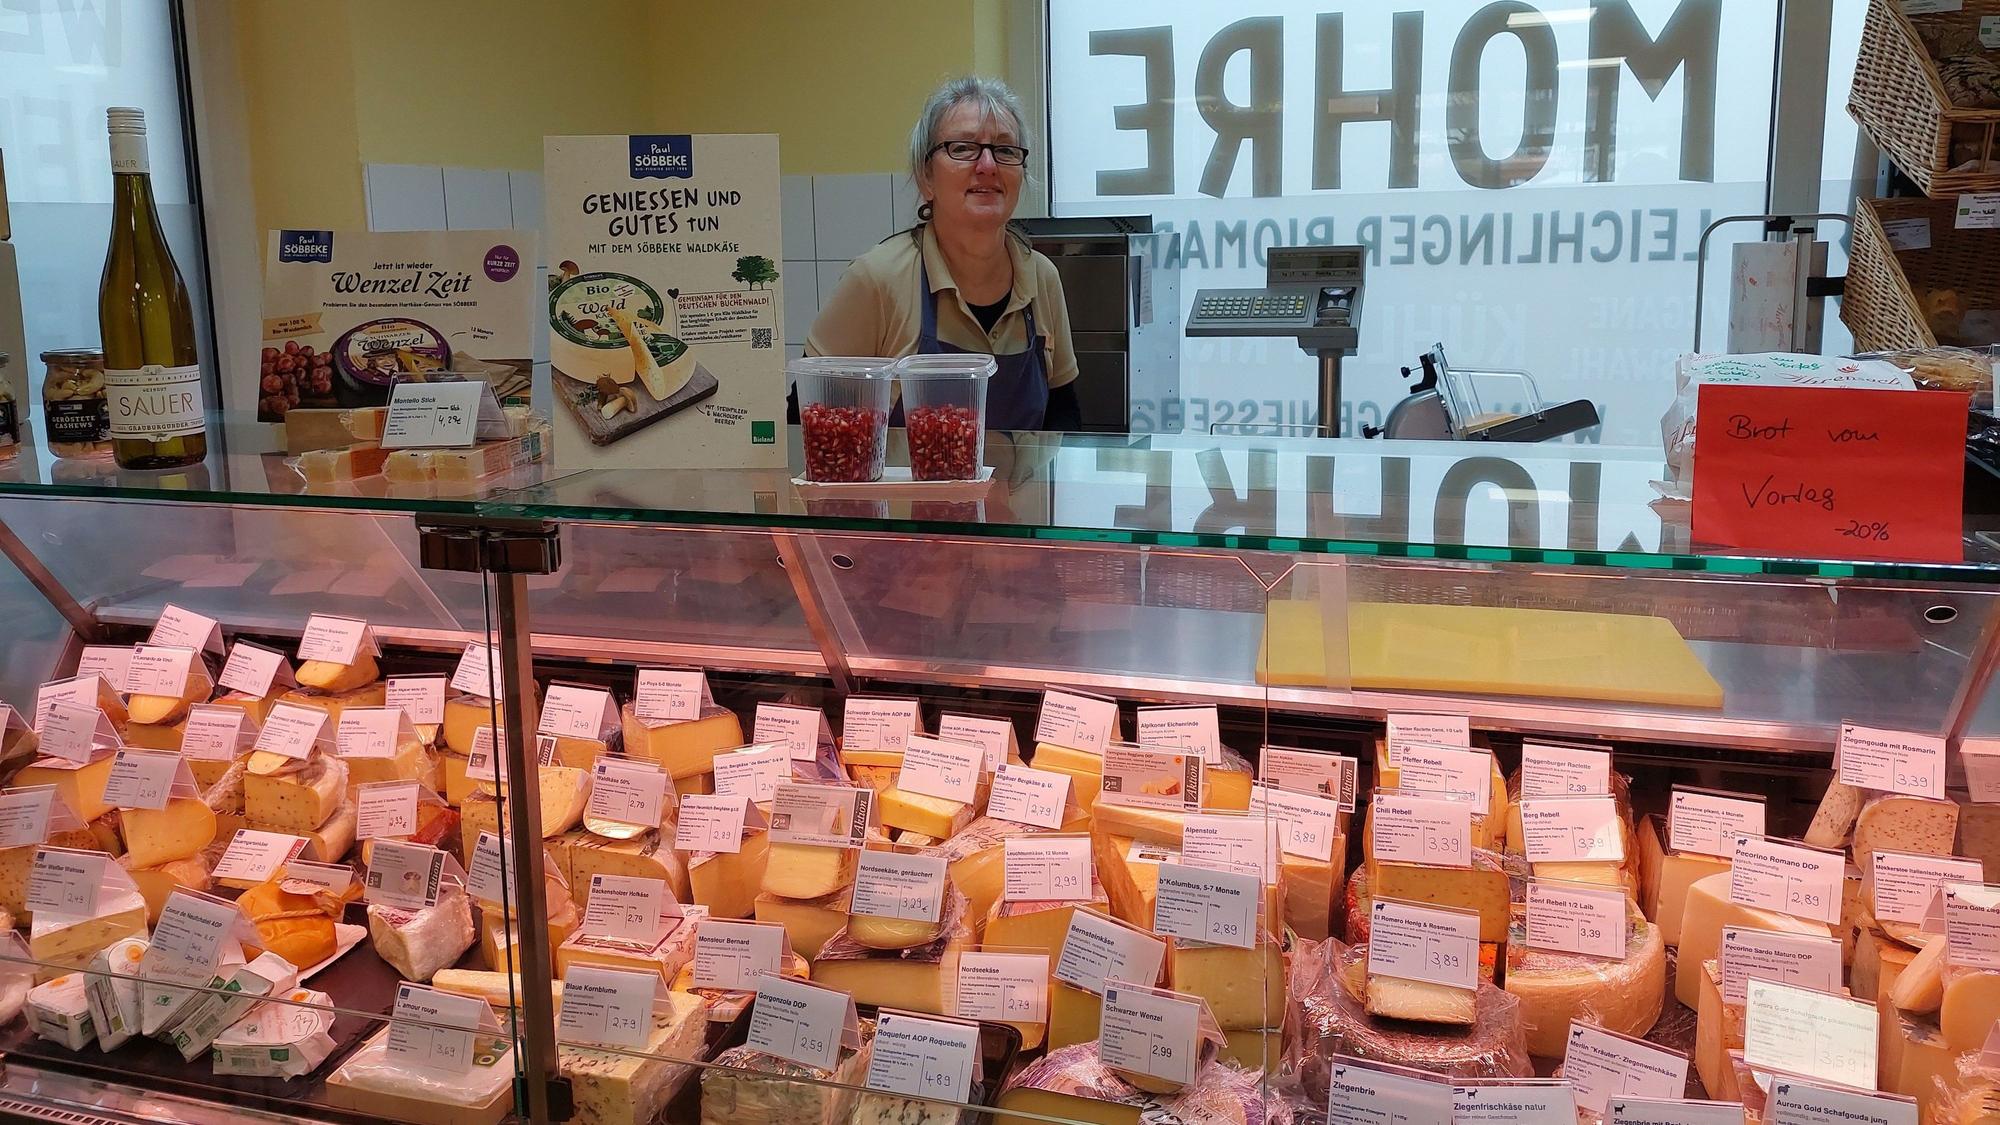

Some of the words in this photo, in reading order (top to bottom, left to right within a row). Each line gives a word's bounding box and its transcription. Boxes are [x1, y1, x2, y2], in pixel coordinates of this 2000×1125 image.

[651, 144, 670, 154] Paul
[635, 154, 687, 167] SÖBBEKE
[582, 188, 698, 214] GENIESSEN
[708, 190, 742, 206] UND
[608, 212, 679, 237] GUTES
[299, 235, 315, 244] Paul
[284, 244, 328, 254] SÖBBEKE
[588, 243, 606, 254] MIT
[612, 243, 632, 254] DEM
[638, 241, 682, 253] SÖBBEKE
[686, 242, 740, 254] WALDKÄSE
[373, 262, 393, 270] Jetzt
[395, 262, 404, 270] ist
[331, 272, 421, 294] Wenzel
[424, 272, 472, 299] Zeit
[586, 286, 610, 296] Bio
[678, 294, 714, 303] GEMEINSAM
[679, 300, 718, 310] DEUTSCHEN
[720, 296, 770, 308] BUCHENWALD!
[578, 298, 626, 315] Wald
[358, 334, 424, 352] Wenzel
[120, 392, 194, 416] SAUER
[51, 413, 97, 424] GERÖSTETE
[55, 421, 94, 430] CASHEWS
[128, 422, 188, 431] GRAUBURGUNDER
[1728, 414, 1793, 441] Brot
[1827, 427, 1880, 442] vom
[1834, 522, 1892, 542] -20%
[672, 700, 686, 708] 3,39
[1044, 700, 1065, 710] Cheddar
[1844, 736, 1888, 749] Ziegengouda
[1890, 742, 1900, 750] mit
[1902, 744, 1936, 755] Rosmarin
[1402, 756, 1424, 766] Pfeffer
[1424, 758, 1442, 766] Rebell
[1525, 756, 1566, 768] Roggenburger
[1567, 762, 1592, 770] Raclette
[596, 774, 619, 784] Waldkäse
[1017, 776, 1040, 786] Bergkäse
[1187, 764, 1200, 802] Aktion
[1340, 768, 1353, 804] Aktion
[1896, 773, 1928, 788] 3,39
[1568, 783, 1587, 793] 2,39
[630, 798, 645, 810] 2,79
[1030, 804, 1051, 817] 2,79
[1376, 806, 1390, 816] Chili
[1390, 808, 1412, 816] Rebell
[856, 800, 868, 839] Aktion
[1524, 811, 1538, 820] Berg
[1185, 826, 1218, 835] Alpenstolz
[1293, 830, 1316, 844] 3,89
[1578, 838, 1604, 850] 3,39
[1736, 848, 1768, 861] Pecorino
[1770, 855, 1801, 868] Romano
[1802, 861, 1820, 871] DOP
[860, 864, 900, 876] Nordseekäse,
[900, 868, 933, 878] geräuchert
[1943, 870, 1965, 880] Kräuter
[1054, 875, 1078, 889] 2,99
[592, 887, 628, 898] Backensholzer
[628, 889, 649, 898] Hofkäse
[1203, 884, 1214, 892] 5-7
[1215, 886, 1240, 896] Monate
[1530, 896, 1545, 905] Senf
[1546, 898, 1567, 908] Rebell
[1568, 901, 1578, 910] 1/2
[1579, 902, 1594, 911] Laib
[1792, 892, 1820, 906] 2,89
[628, 913, 644, 924] 2,79
[1212, 922, 1238, 936] 2,89
[1405, 920, 1421, 930] Honig
[1428, 924, 1457, 933] Rosmarin
[1580, 926, 1601, 940] 3,39
[698, 936, 725, 944] Monsieur
[726, 937, 750, 946] Bernard
[1071, 924, 1114, 946] Bernsteinkäse
[1725, 943, 1752, 954] Pecorino
[1754, 946, 1773, 956] Sardo
[1774, 950, 1796, 959] Maturo
[1796, 952, 1812, 960] DOP
[1430, 951, 1460, 970] 3,89
[961, 966, 1000, 975] Nordseekäse
[566, 982, 582, 992] Blaue
[583, 984, 618, 995] Kornblume
[758, 992, 792, 1008] Gorgonzola
[794, 1001, 808, 1010] DOP
[1008, 998, 1031, 1012] 2,79
[1105, 1004, 1138, 1018] Schwarzer
[1139, 1010, 1164, 1022] Wenzel
[612, 1016, 637, 1030] 2,79
[800, 1038, 823, 1052] 2,59
[878, 1028, 910, 1042] Roquefort
[912, 1033, 928, 1043] AOP
[929, 1036, 967, 1049] Roquebelle
[1152, 1044, 1172, 1058] 2,99
[1570, 1040, 1590, 1051] Merlin
[1622, 1056, 1678, 1080] Ziegenweichkäse
[1332, 1081, 1376, 1097] Ziegenbrie
[1453, 1102, 1523, 1114] Ziegenfrischkäse
[1524, 1102, 1546, 1112] natur
[1776, 1100, 1802, 1111] Aurora
[1804, 1104, 1822, 1114] Gold
[1824, 1106, 1869, 1122] Schafgouda
[1870, 1114, 1888, 1125] jung
